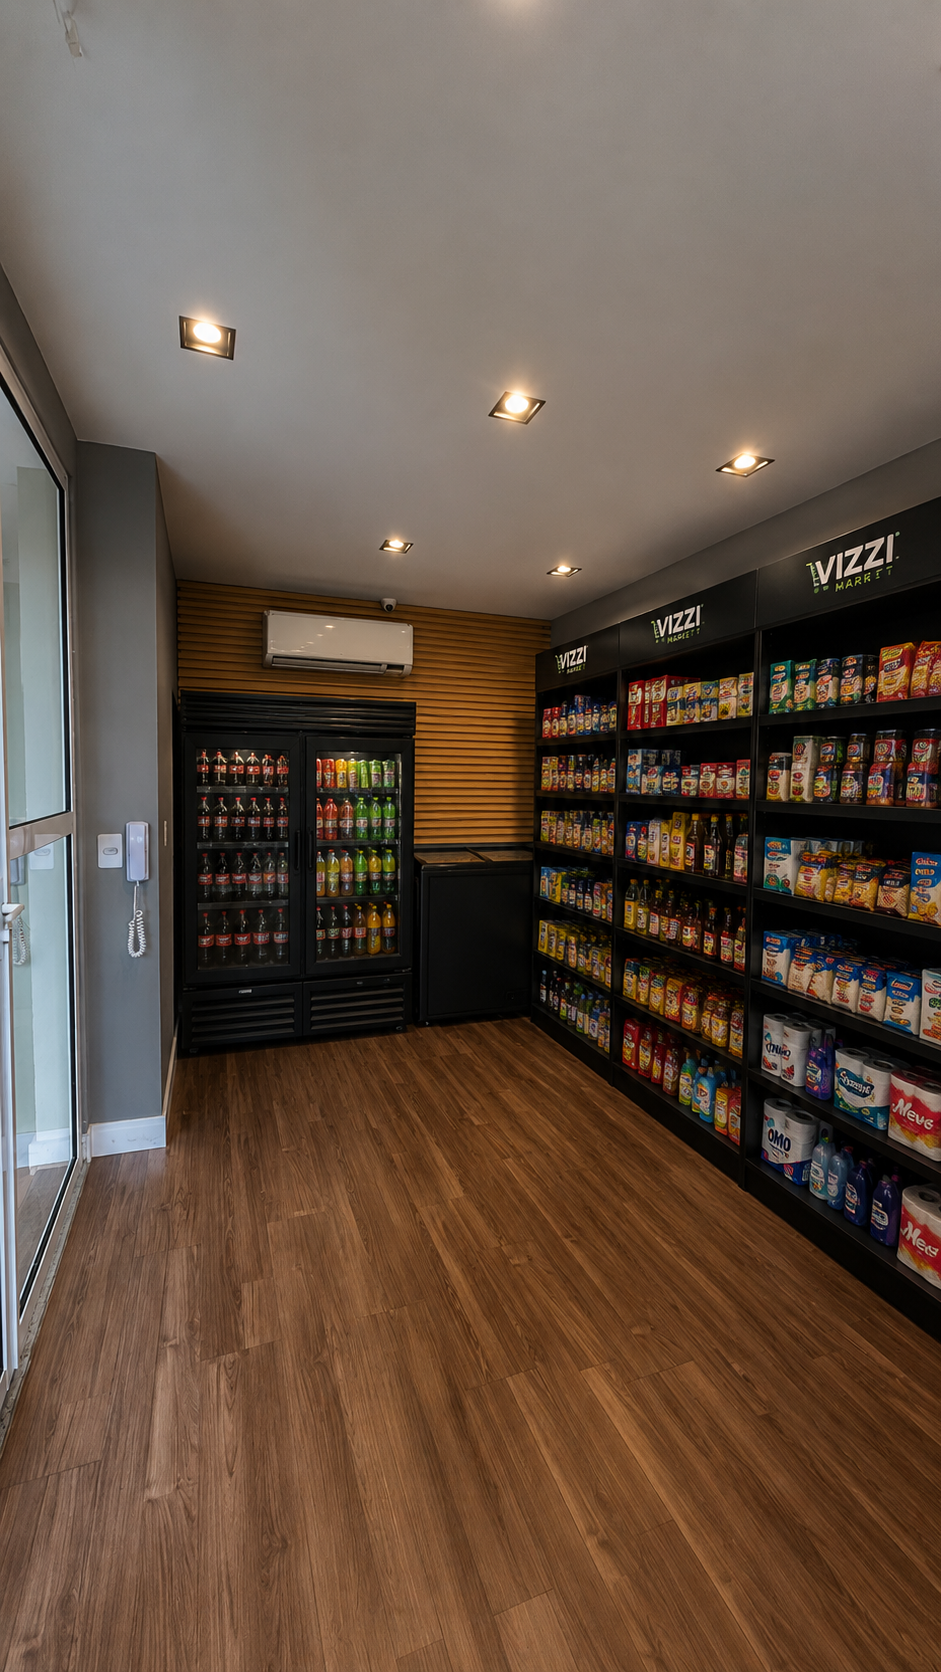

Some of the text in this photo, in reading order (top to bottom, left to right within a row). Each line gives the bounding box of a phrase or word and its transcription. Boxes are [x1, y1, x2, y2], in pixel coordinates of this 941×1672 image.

[815, 533, 895, 585] VIZZI
[656, 604, 701, 638] VIZZI
[559, 645, 587, 670] VIZZI
[768, 1127, 792, 1152] OMO
